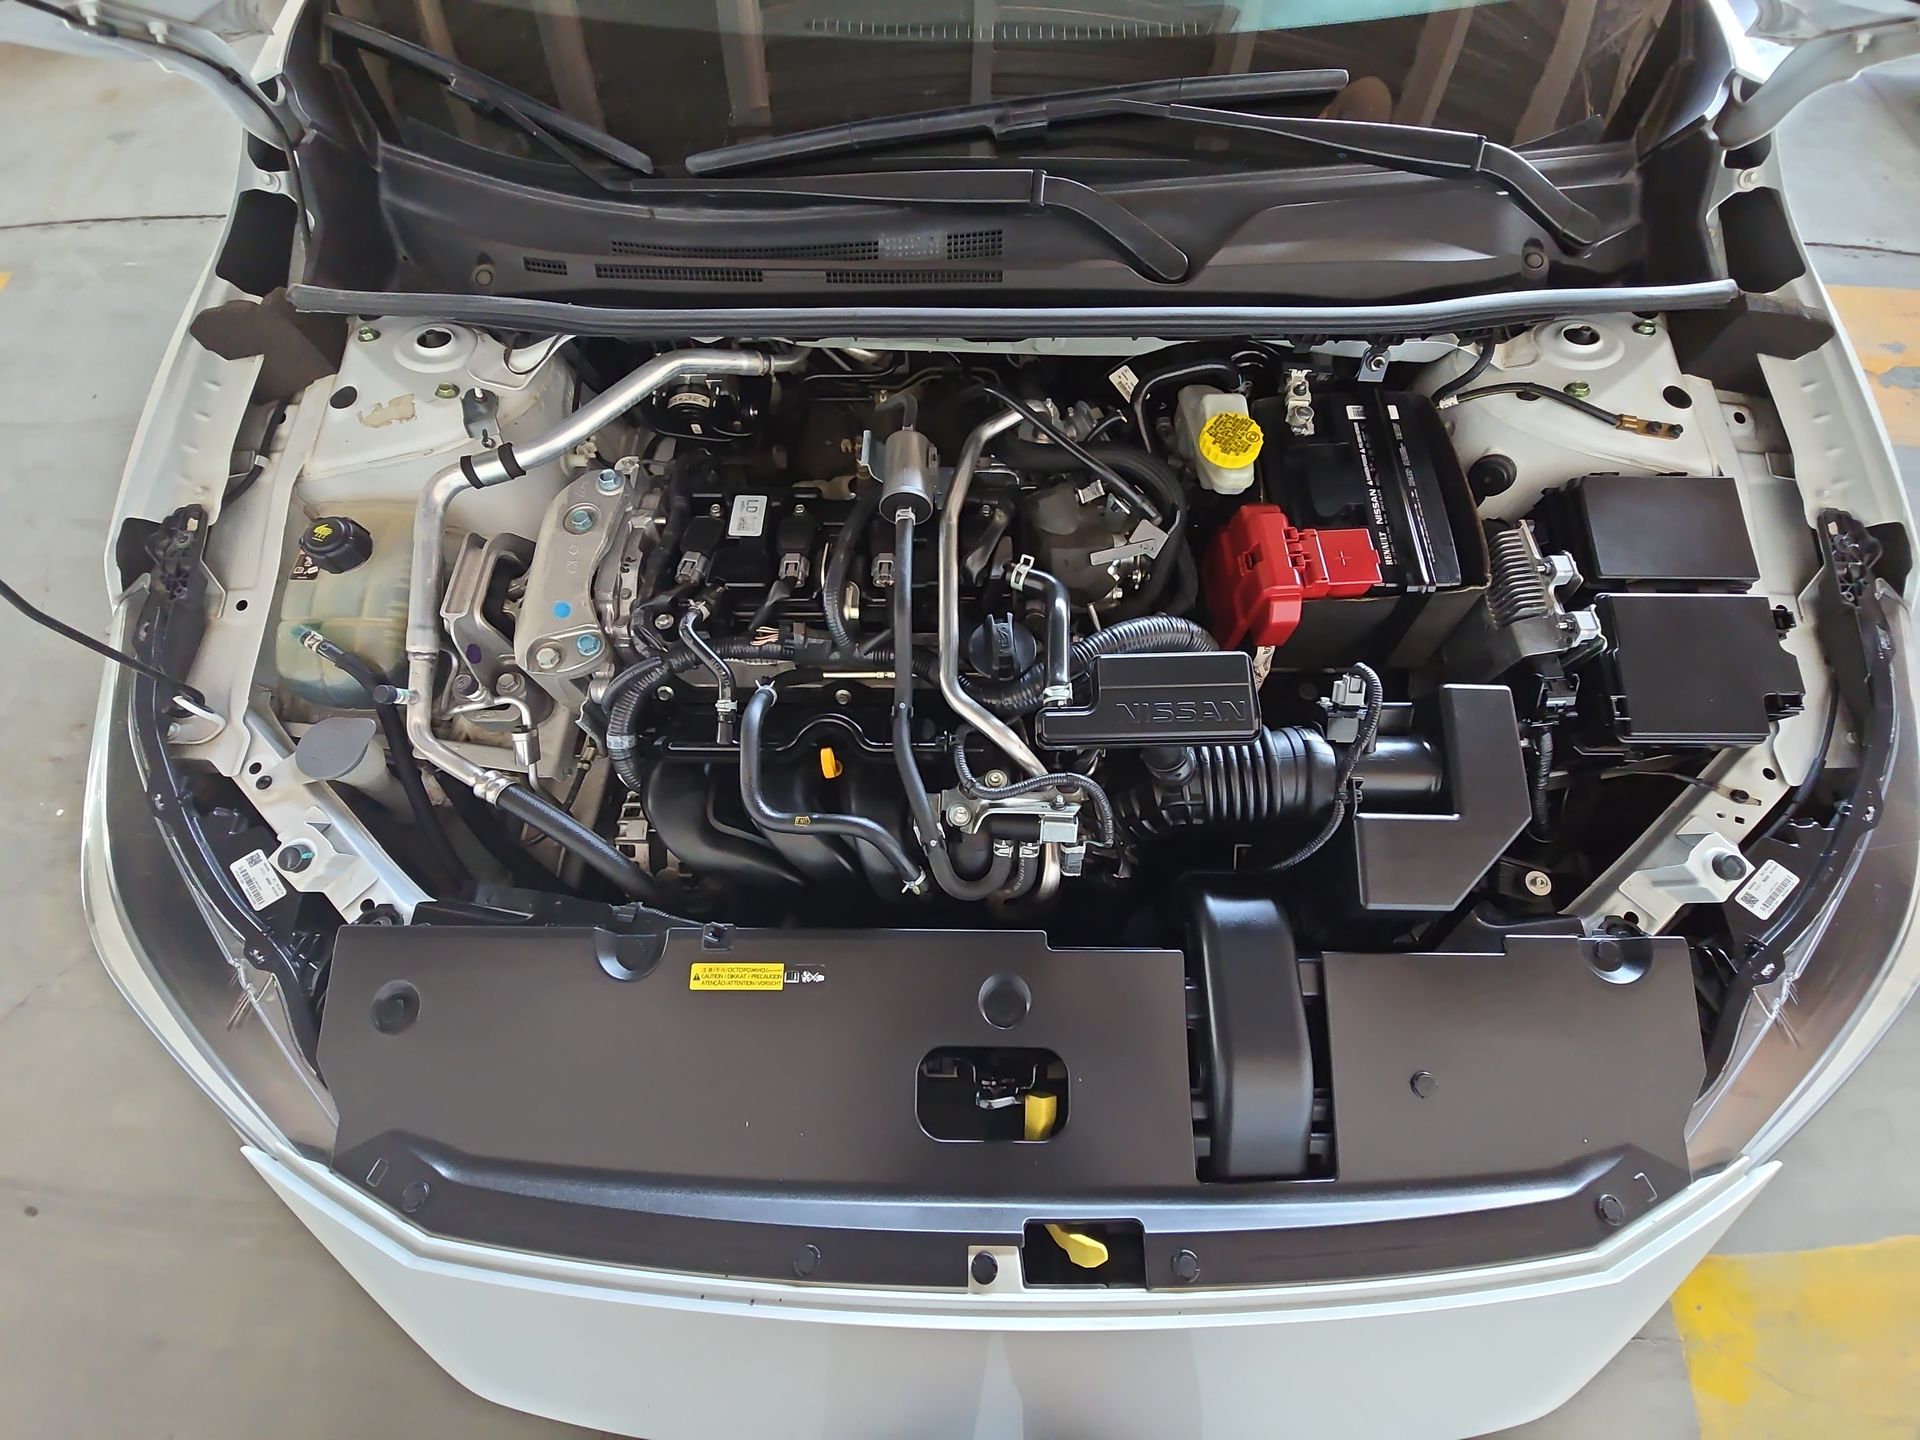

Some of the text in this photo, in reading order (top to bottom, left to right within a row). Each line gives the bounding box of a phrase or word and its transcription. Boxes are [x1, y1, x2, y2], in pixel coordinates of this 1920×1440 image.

[1368, 488, 1385, 525] NISSAN
[1378, 531, 1394, 566] RENAULT
[1115, 700, 1247, 723] NISSAN
